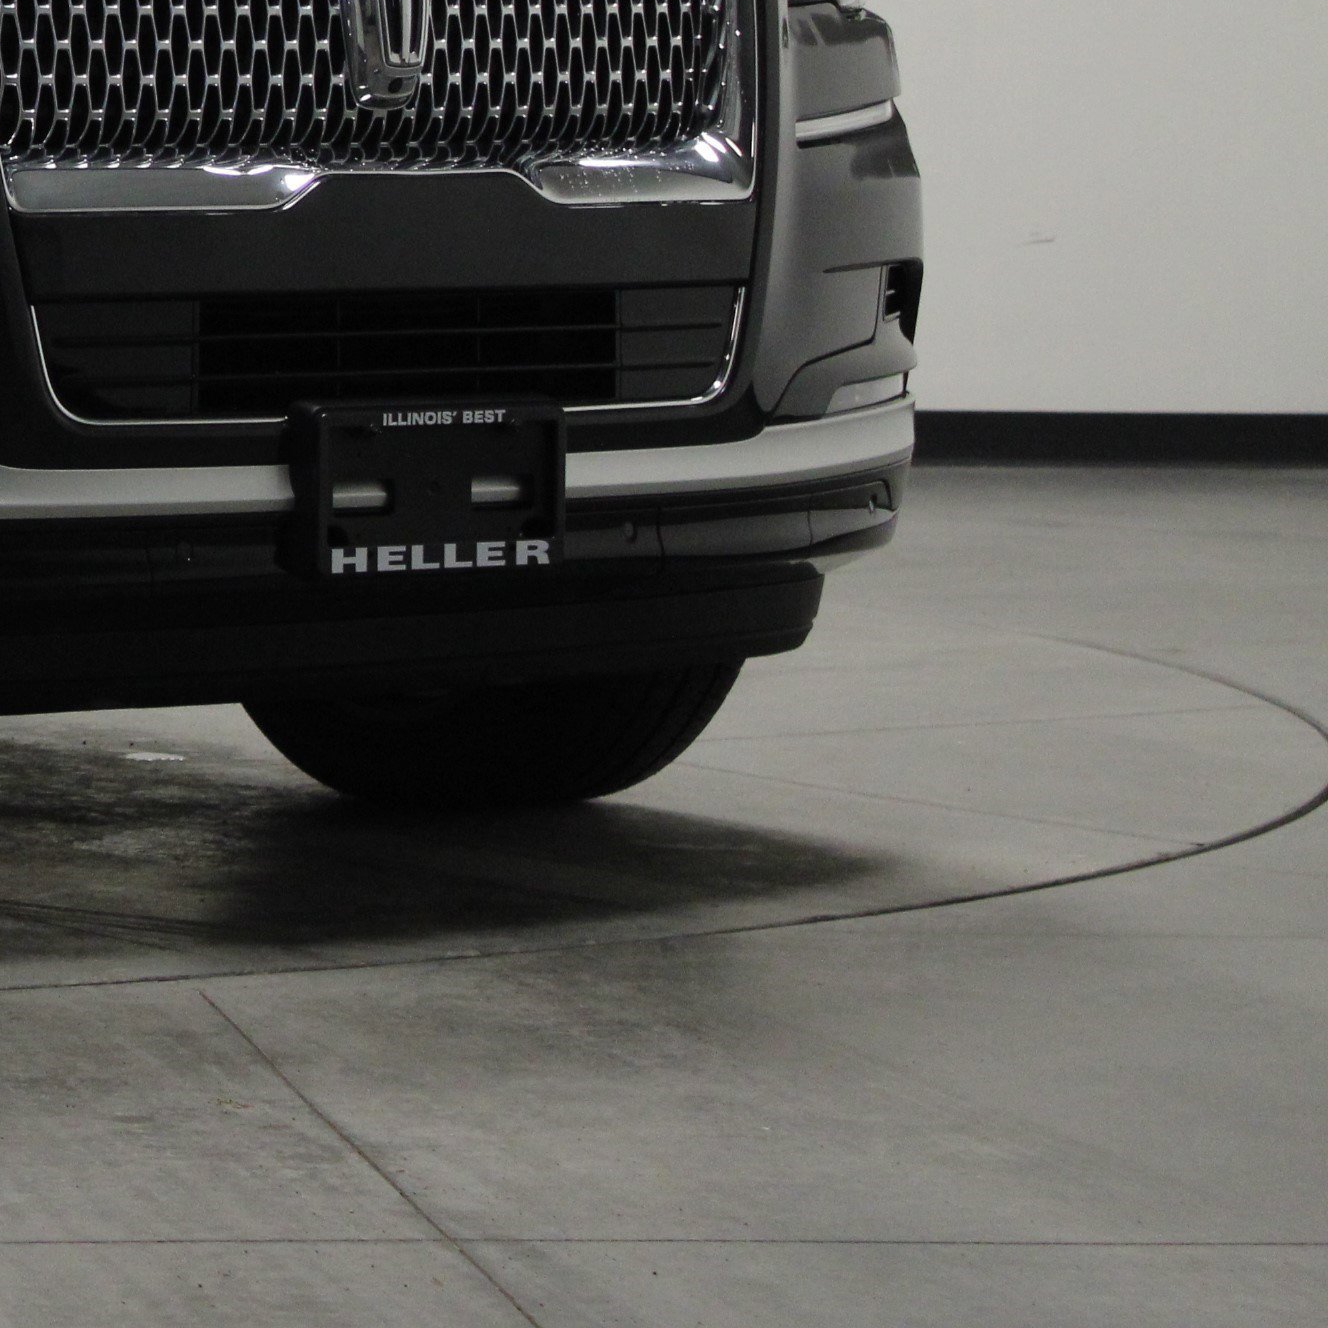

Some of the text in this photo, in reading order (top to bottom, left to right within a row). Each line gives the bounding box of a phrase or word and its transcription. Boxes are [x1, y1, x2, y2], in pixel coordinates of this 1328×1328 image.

[382, 409, 506, 426] ILLINOIS' BEST
[330, 539, 550, 574] HELLER
